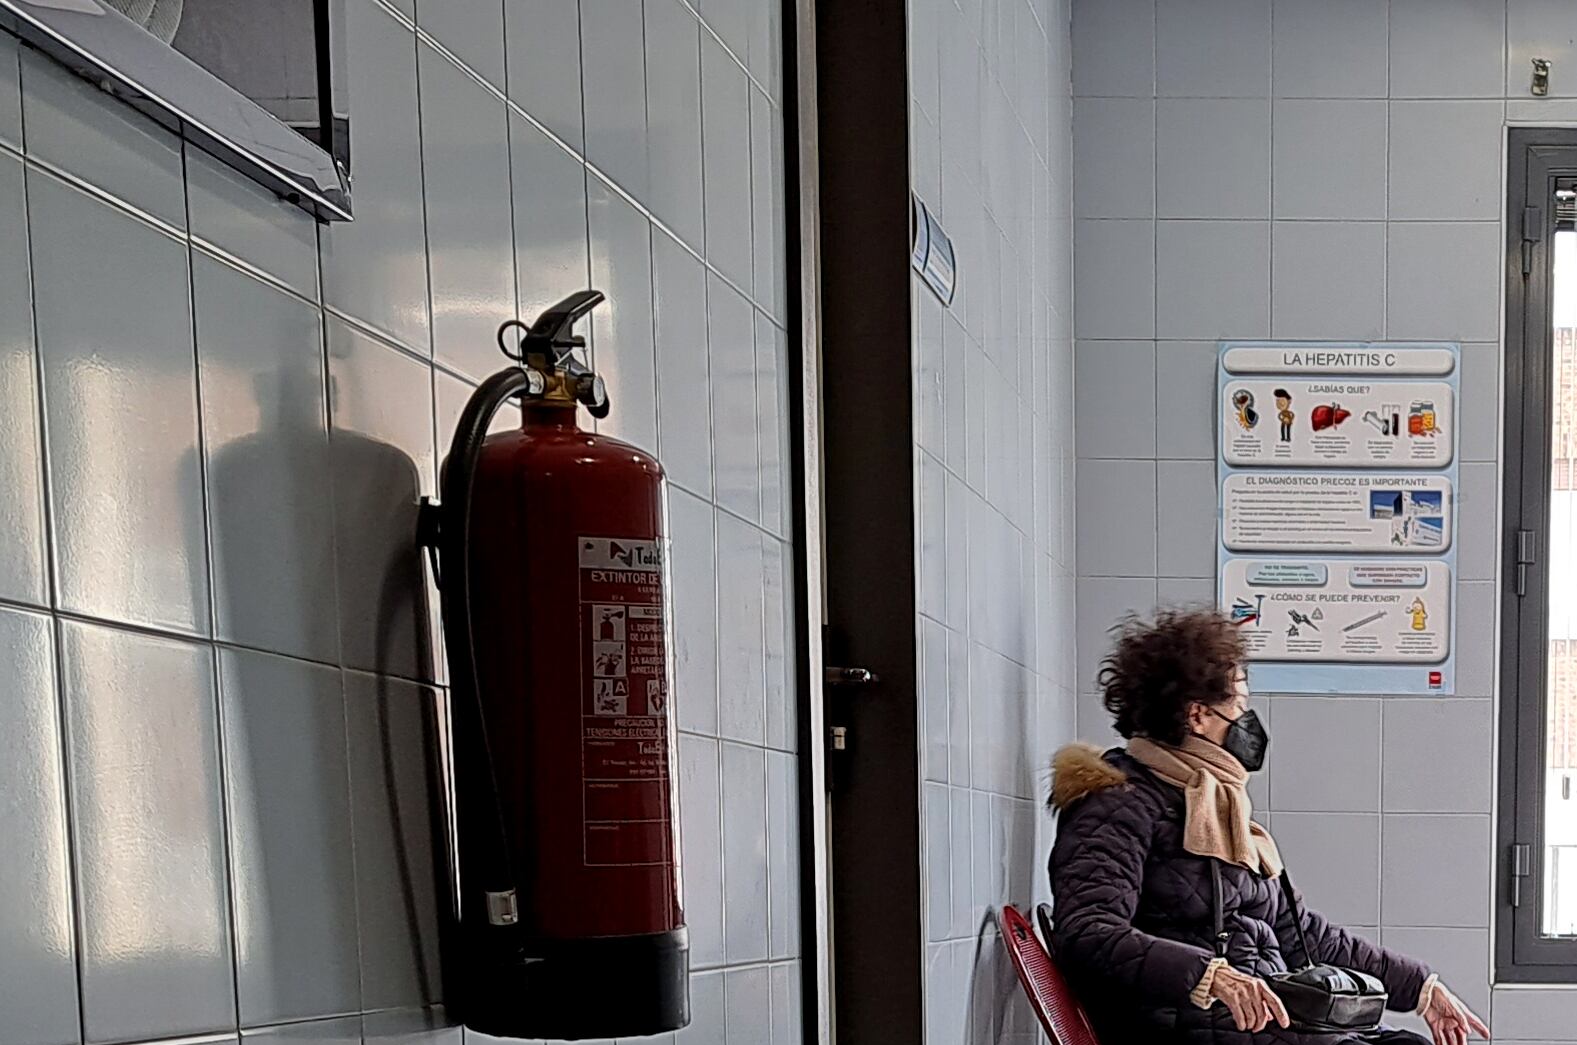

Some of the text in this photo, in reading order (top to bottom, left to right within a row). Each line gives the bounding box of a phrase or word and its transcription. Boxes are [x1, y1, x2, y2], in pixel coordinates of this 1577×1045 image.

[1283, 353, 1396, 367] LA HEPATITIS C
[1308, 385, 1371, 395] ¿SABÍAS QUE?
[1246, 475, 1428, 487] EL DIAGNÓSTICO PRECOZ ES IMPORTANTE
[591, 570, 659, 585] EXTINTOR DE
[1270, 593, 1401, 603] ¿CÓMO SE PUEDE PREVENIR?
[614, 681, 627, 694] A
